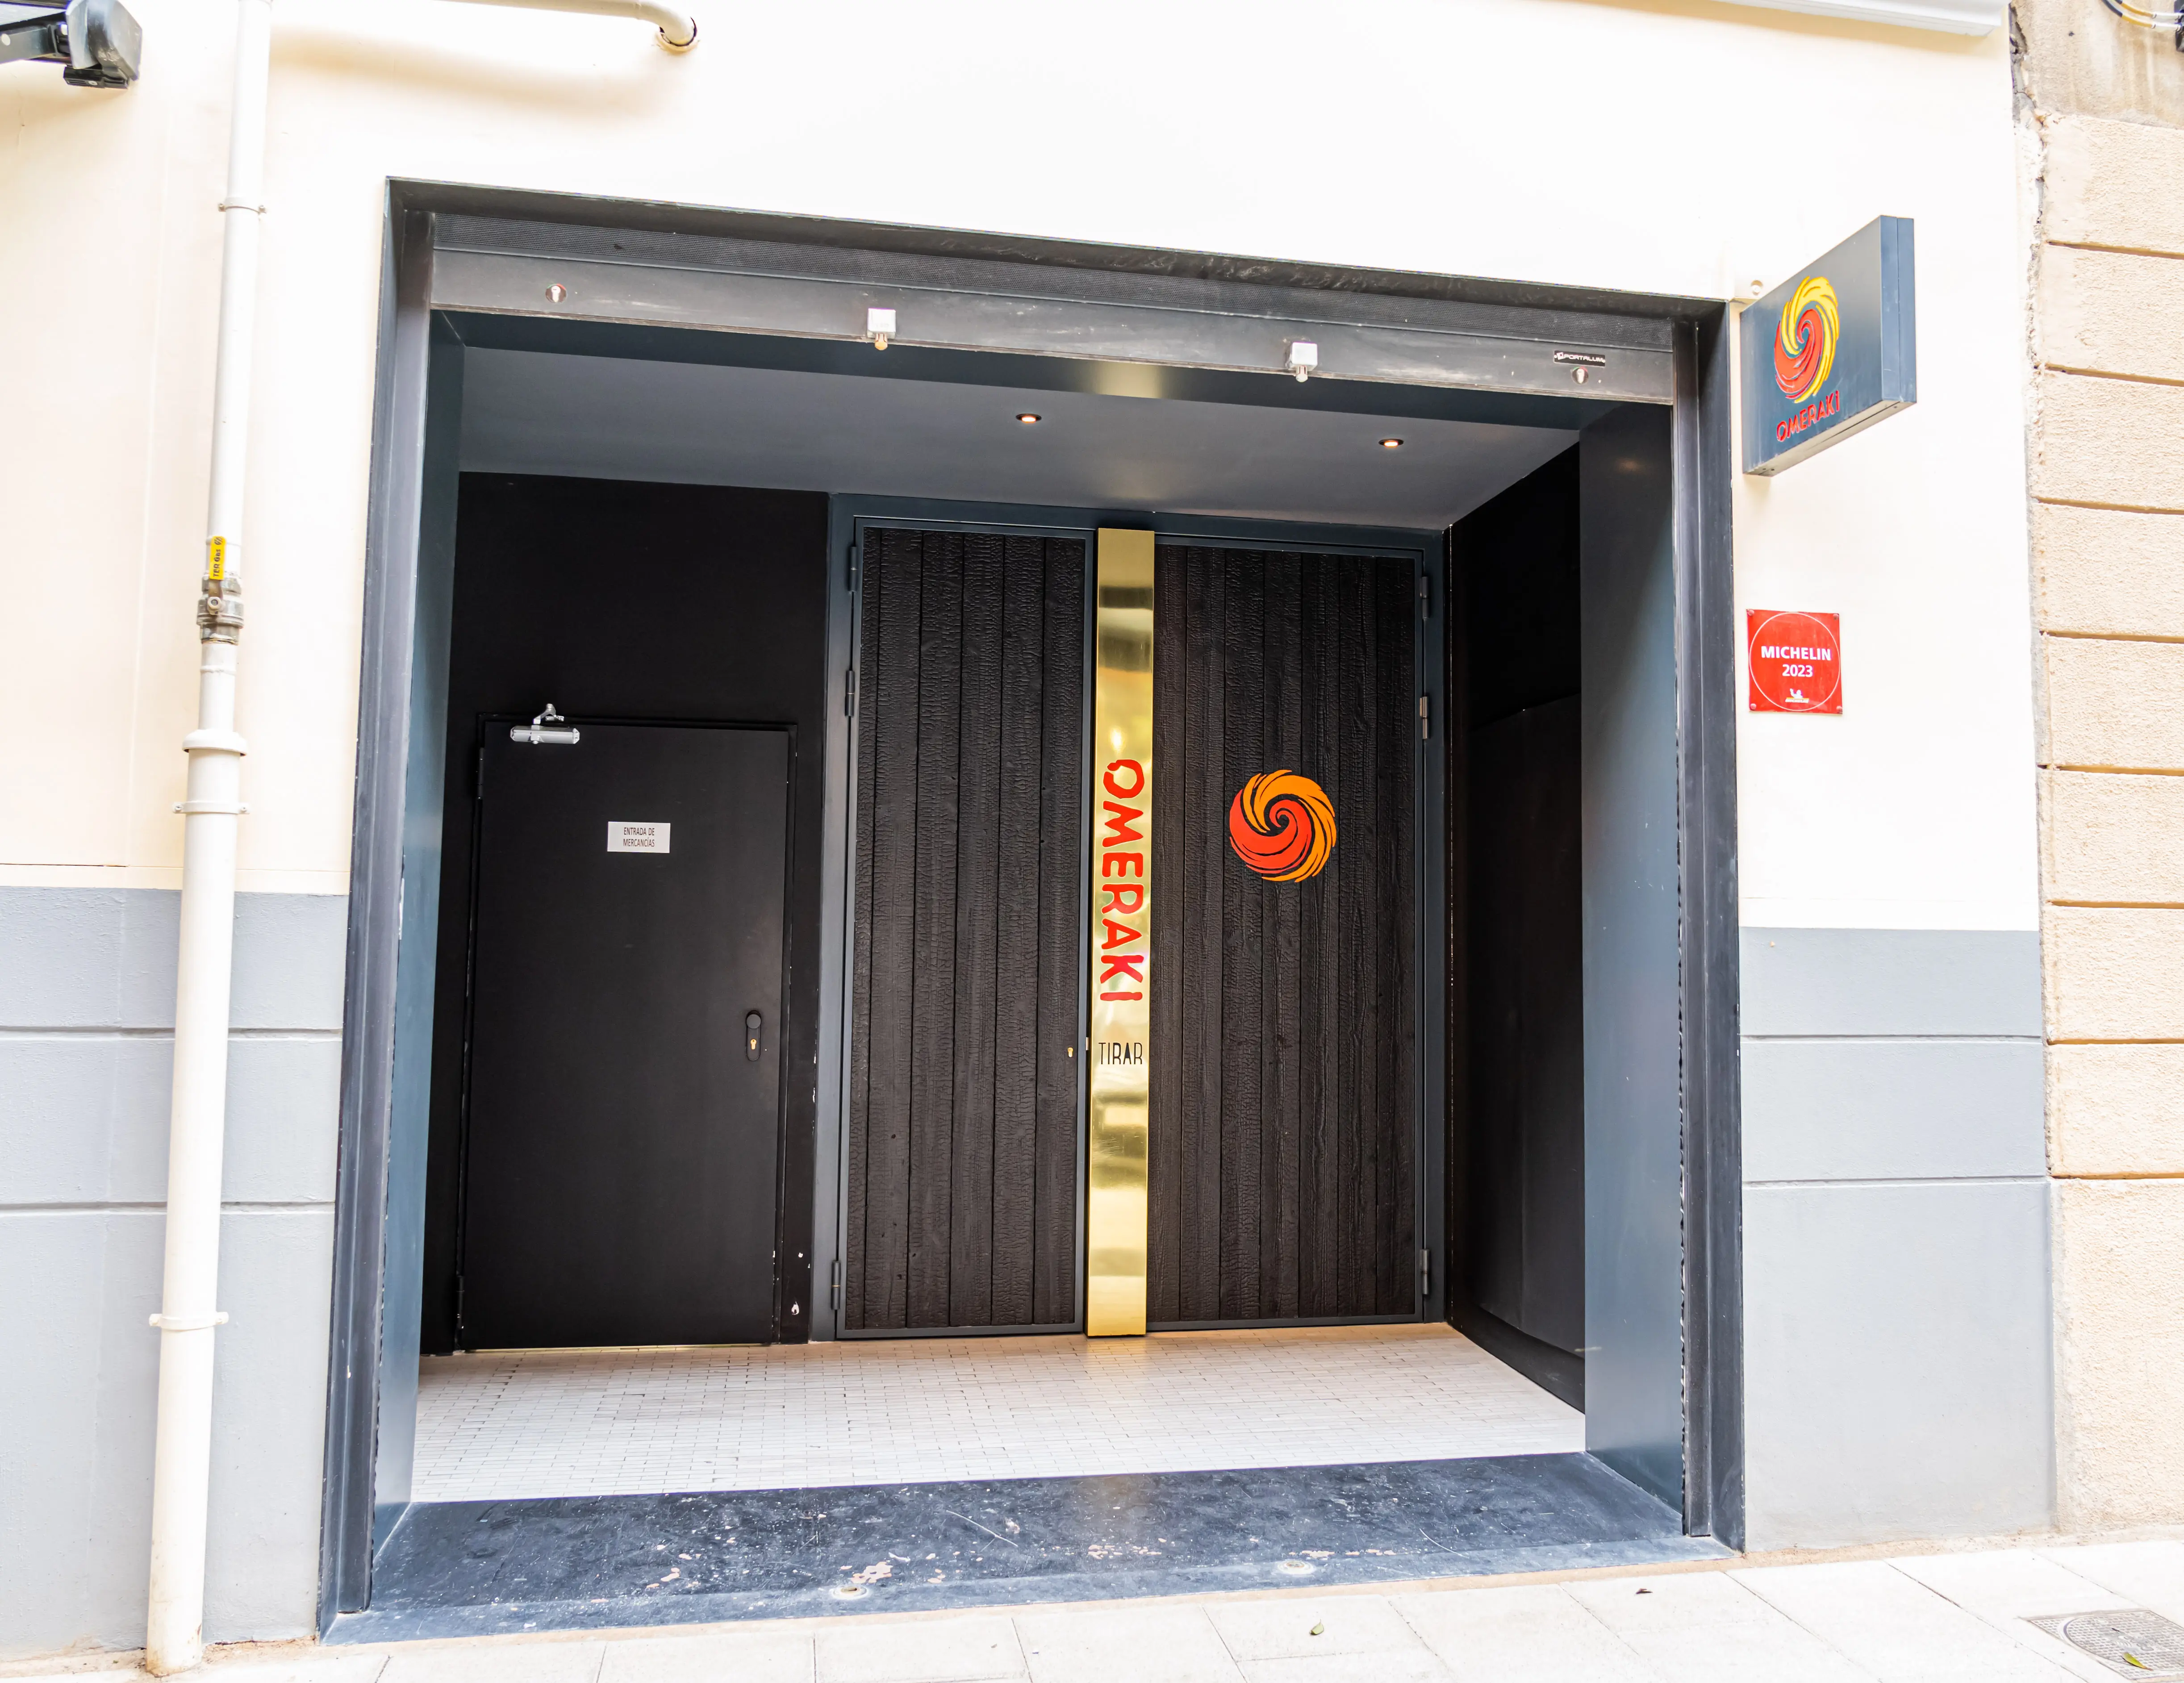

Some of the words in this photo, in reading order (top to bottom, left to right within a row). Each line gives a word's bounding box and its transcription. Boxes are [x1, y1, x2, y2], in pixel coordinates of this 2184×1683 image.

[1563, 354, 1603, 363] PORTALUM
[1776, 390, 1840, 442] OMERAKI
[1761, 646, 1831, 661] MICHELIN
[1782, 664, 1813, 677] 2023
[624, 827, 647, 836] ENTRADA
[648, 828, 655, 836] DE
[623, 837, 655, 847] MERCANCÍAS
[1100, 759, 1145, 1002] OMERAKI
[1098, 1042, 1143, 1065] TIRAR
